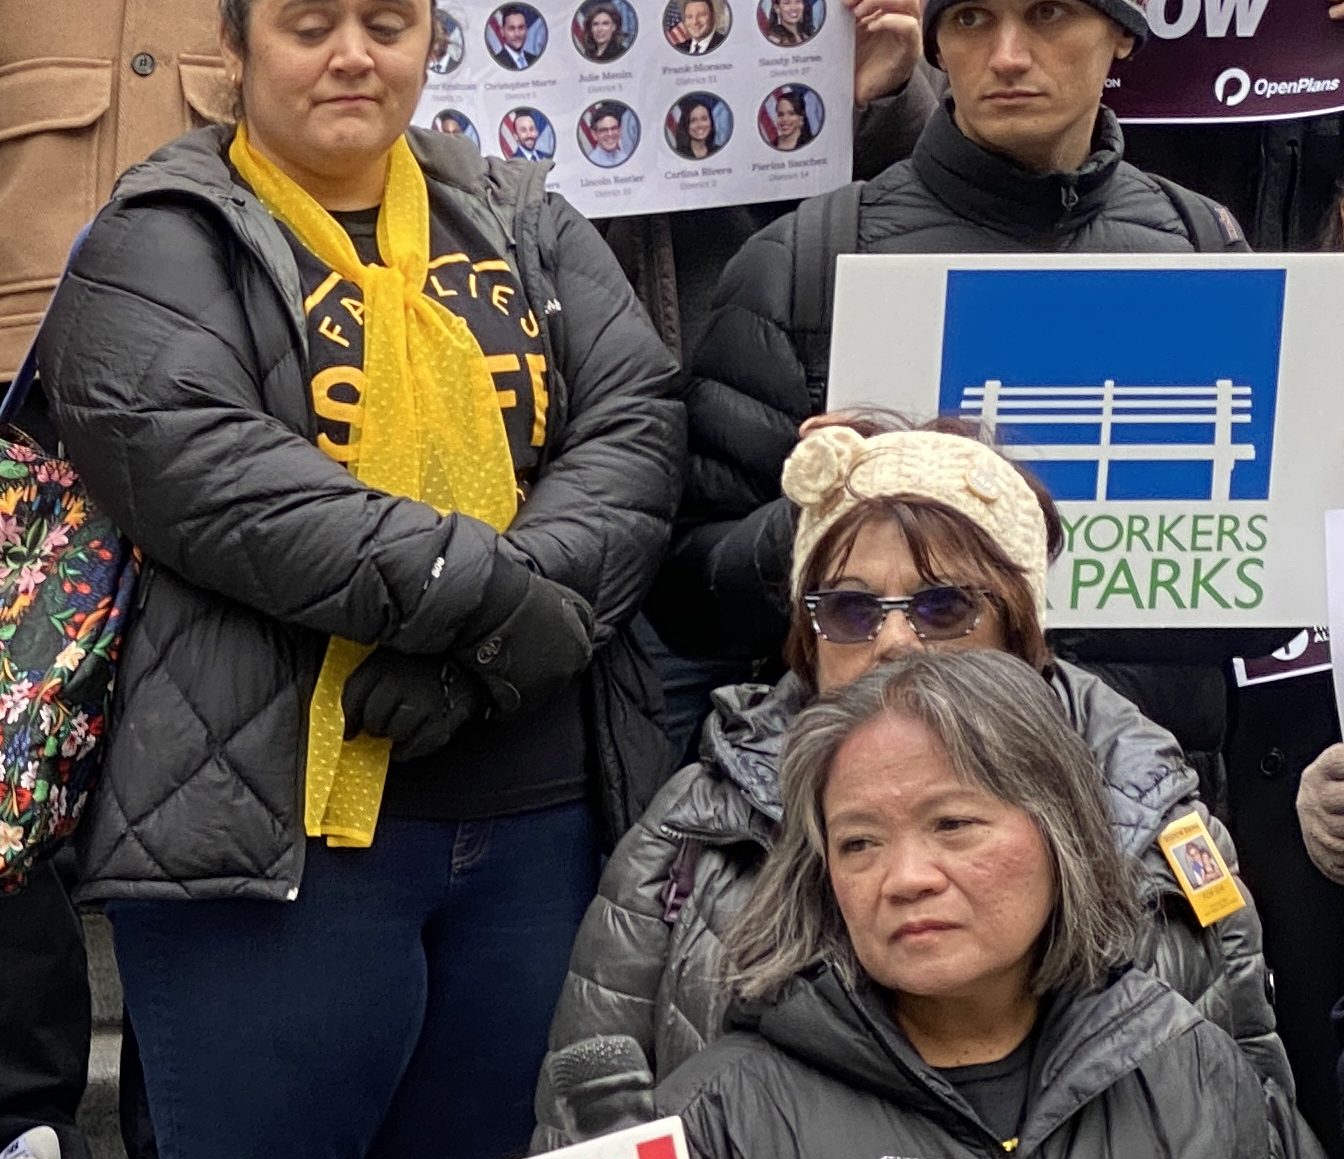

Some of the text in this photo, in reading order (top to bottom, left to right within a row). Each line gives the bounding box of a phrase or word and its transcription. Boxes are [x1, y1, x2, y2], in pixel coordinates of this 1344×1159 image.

[1254, 77, 1340, 98] OpenPlans
[1060, 514, 1268, 552] YORKERS
[1070, 558, 1265, 610] PARKS
